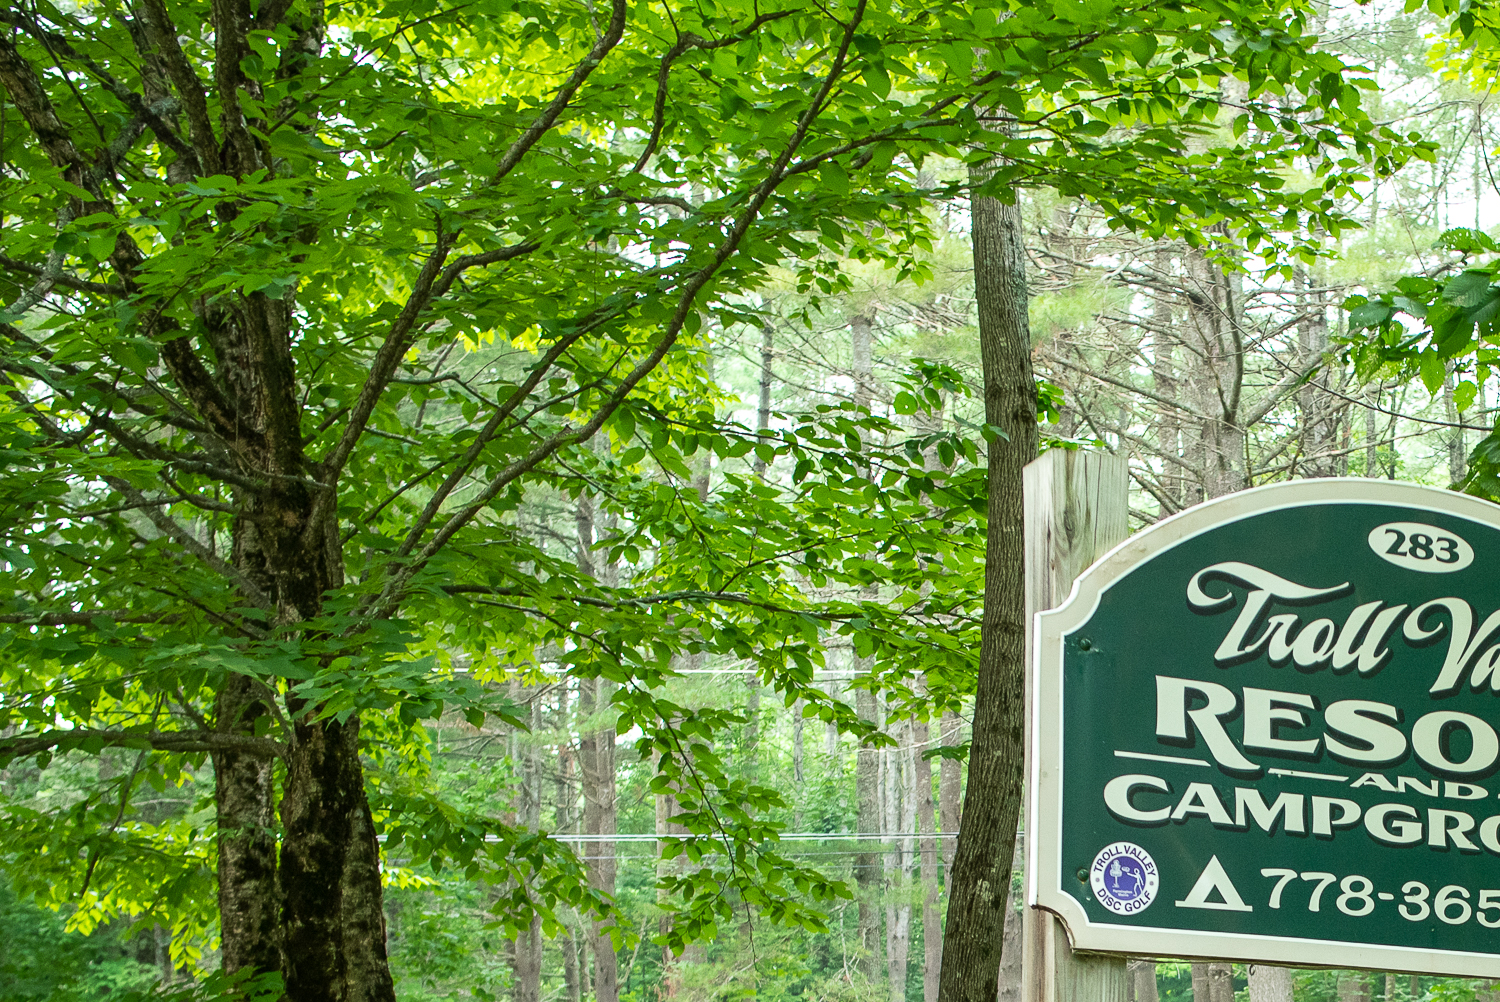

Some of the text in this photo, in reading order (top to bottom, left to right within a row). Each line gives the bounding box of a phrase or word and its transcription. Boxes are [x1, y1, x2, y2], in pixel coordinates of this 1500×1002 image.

[1384, 528, 1460, 565] 283
[1186, 561, 1407, 672] Troll
[1348, 767, 1489, 800] AND
[1093, 845, 1156, 876] TROLL VALLEY
[1097, 889, 1151, 912] DISC GOLF
